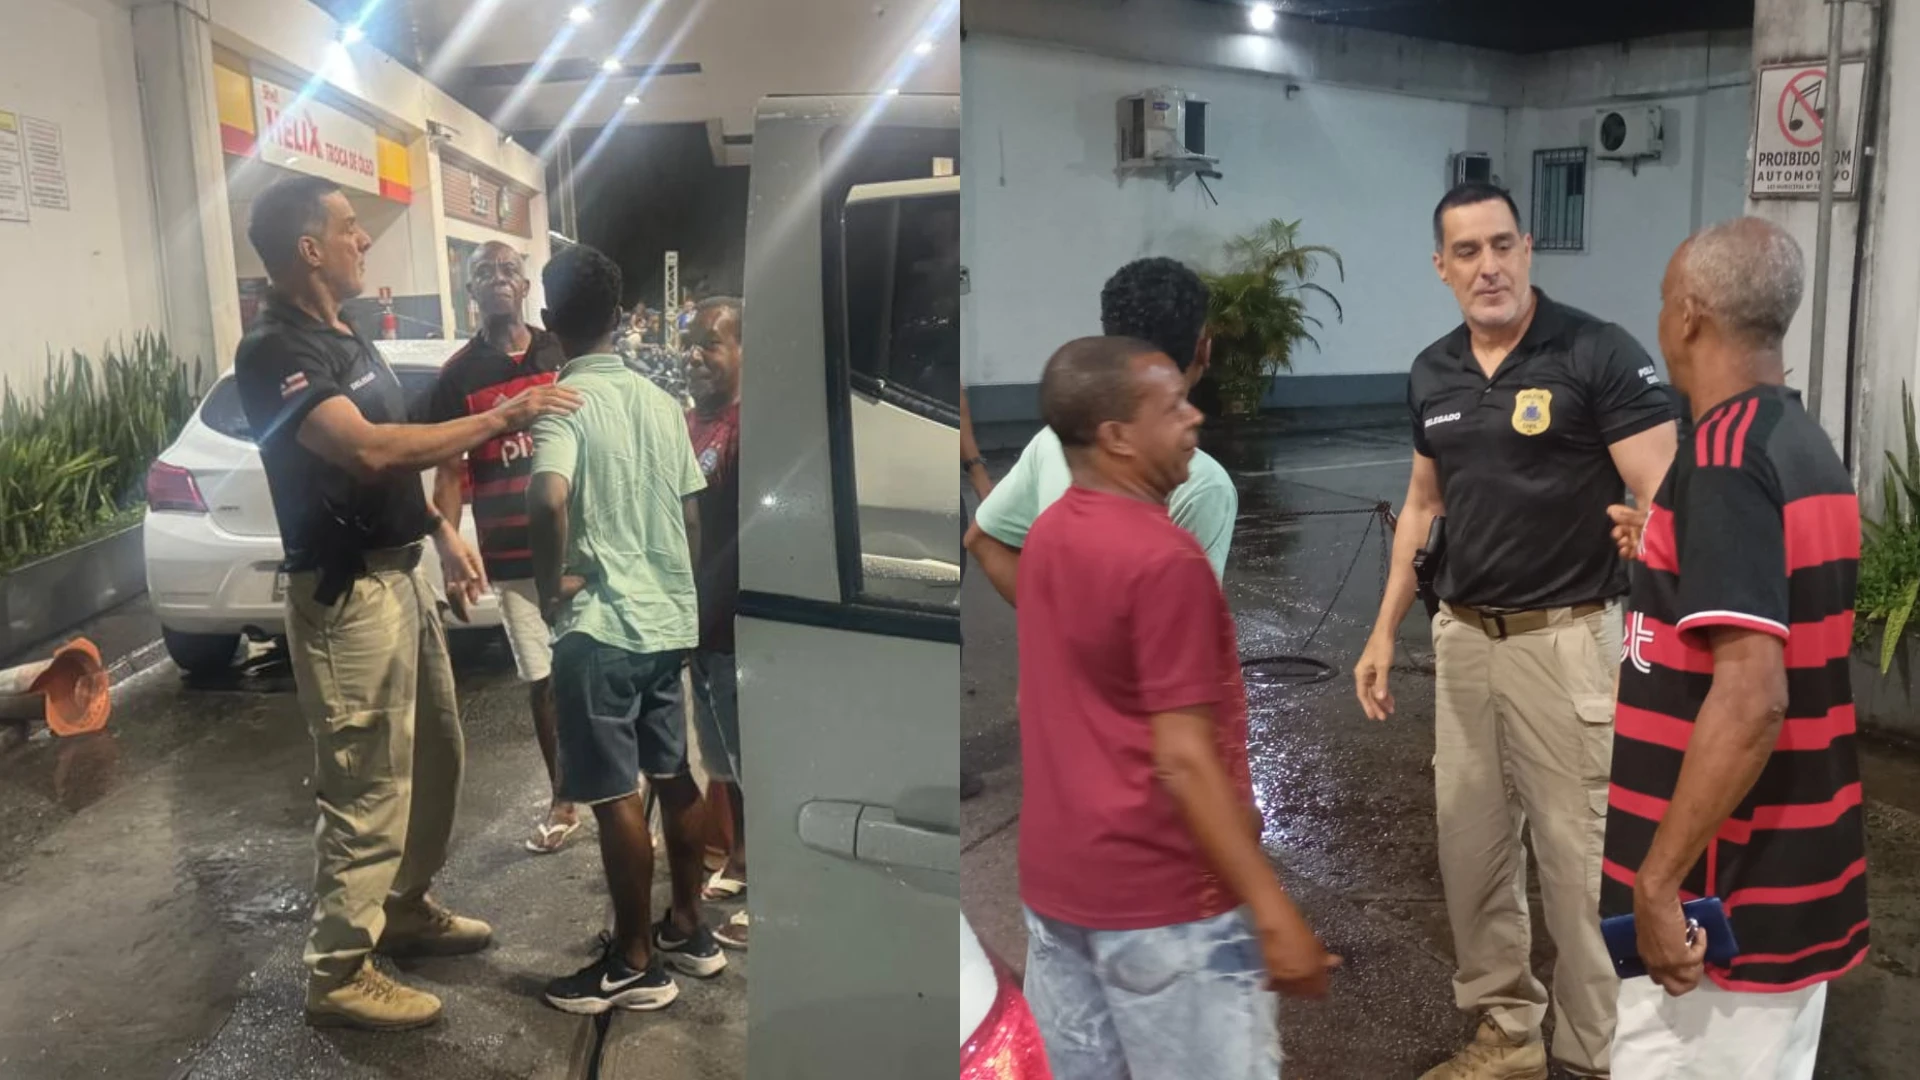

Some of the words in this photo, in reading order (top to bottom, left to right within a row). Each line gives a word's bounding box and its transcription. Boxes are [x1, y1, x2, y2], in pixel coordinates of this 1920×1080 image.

[266, 106, 324, 158] HELIX
[1759, 151, 1820, 167] PROIBIDO
[1757, 170, 1850, 182] AUTOMOTVO
